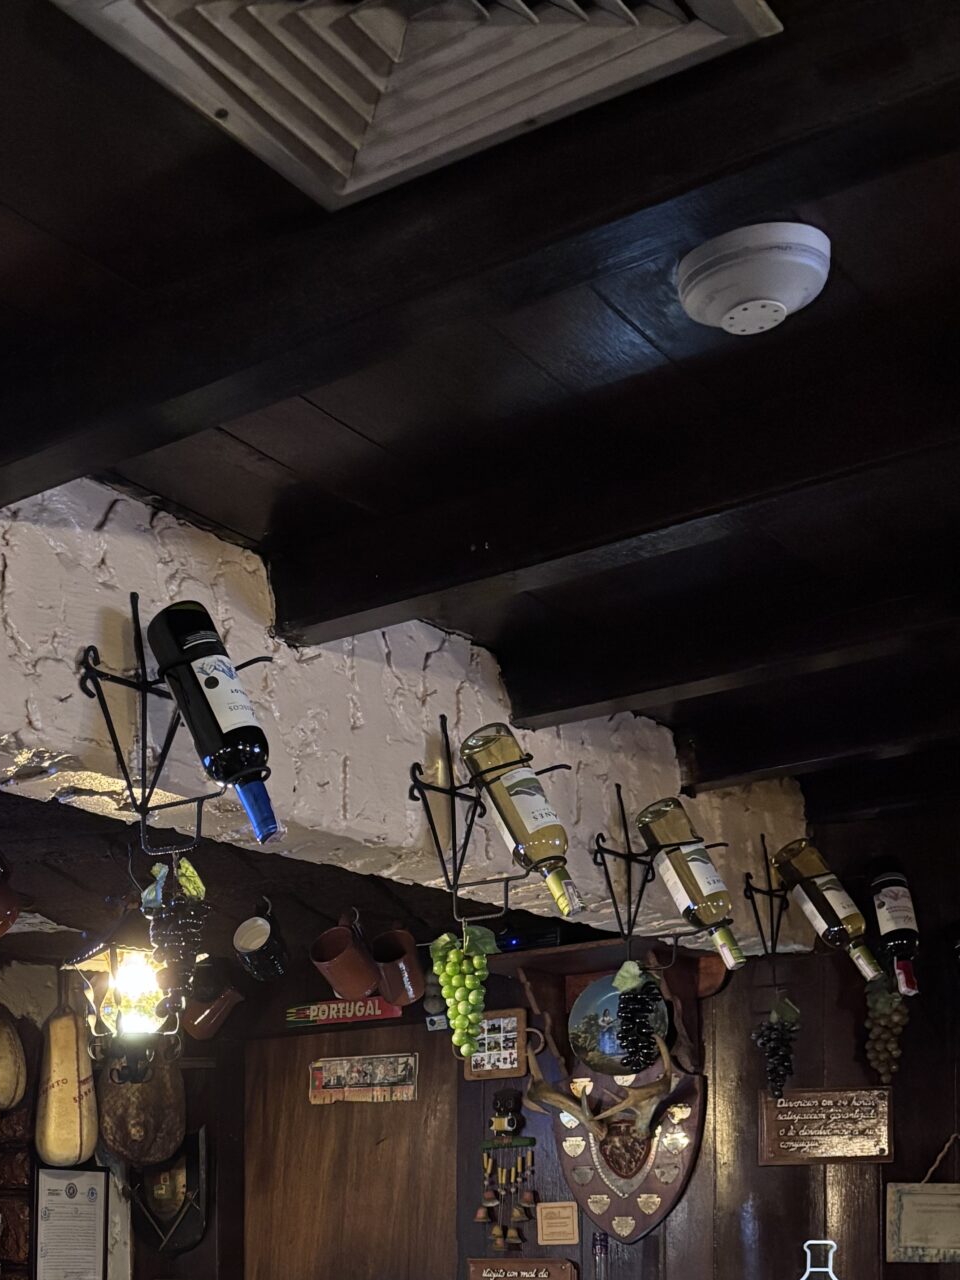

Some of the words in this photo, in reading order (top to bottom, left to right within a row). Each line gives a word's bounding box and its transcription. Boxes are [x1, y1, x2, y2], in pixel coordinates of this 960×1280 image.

[309, 1000, 382, 1021] PORTUGAL
[520, 1268, 536, 1278] mal
[538, 1268, 549, 1278] de
